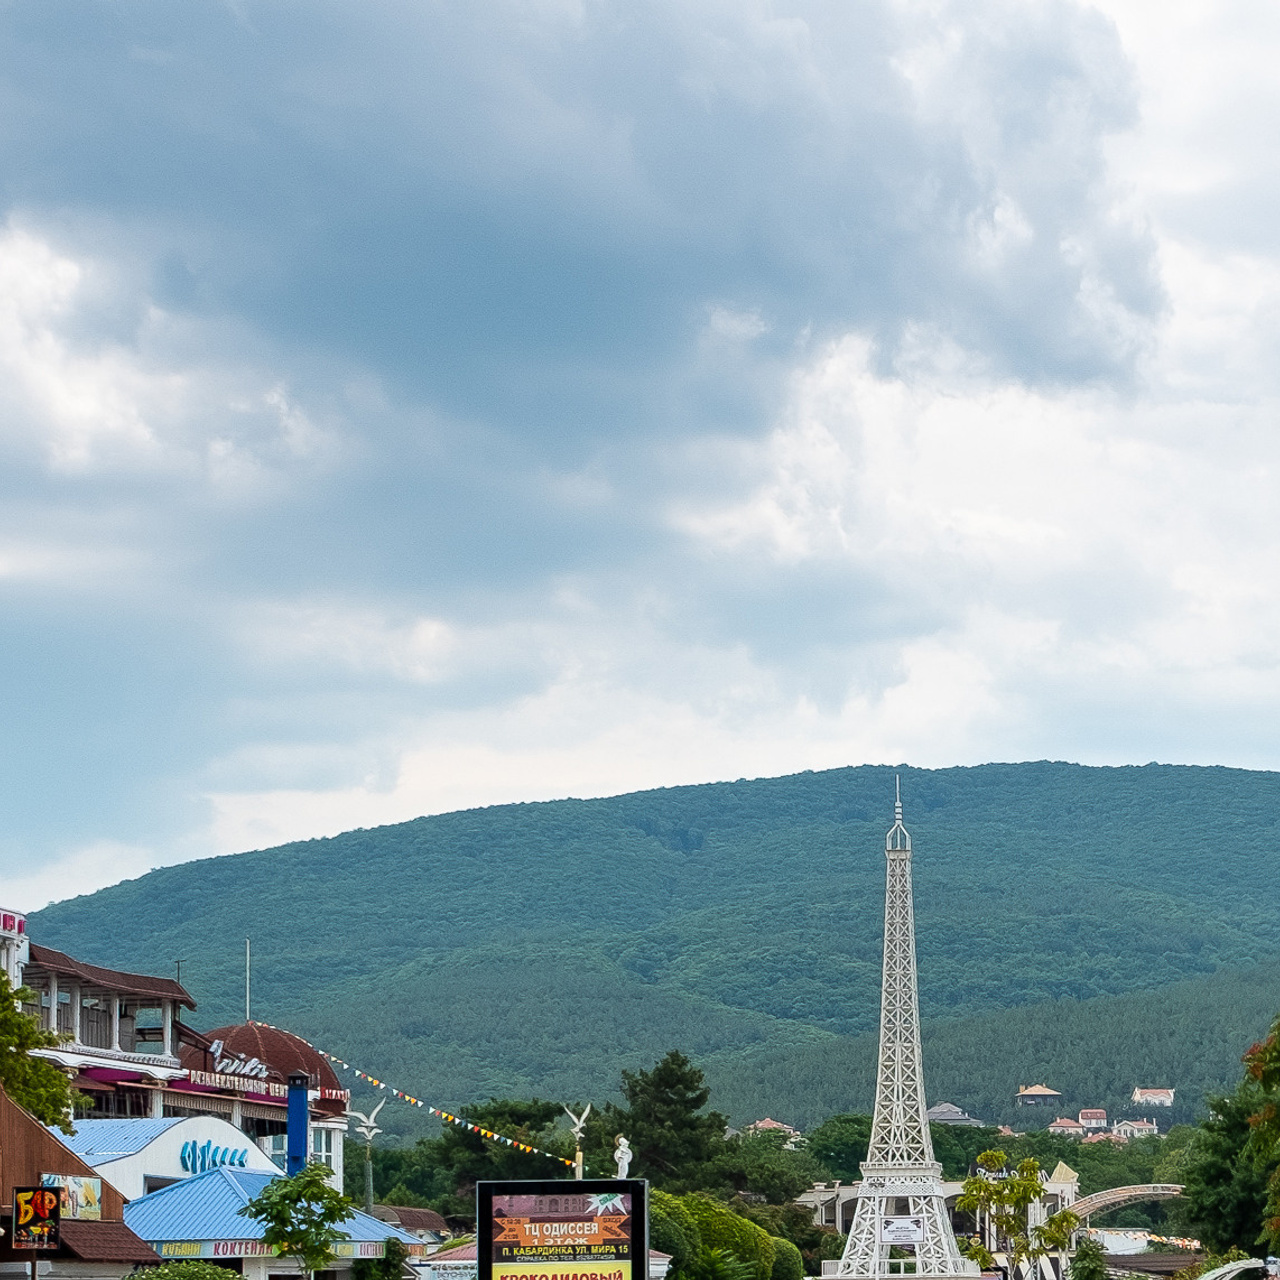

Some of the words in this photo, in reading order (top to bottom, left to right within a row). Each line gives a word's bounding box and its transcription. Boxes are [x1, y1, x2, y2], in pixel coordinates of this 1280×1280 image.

[269, 1082, 288, 1098] ЦЕНТ
[524, 1223, 540, 1237] ТЦ
[543, 1223, 599, 1236] ОДИССЕЯ
[544, 1237, 588, 1245] ЭТАЖ
[503, 1248, 512, 1256] П.
[513, 1247, 573, 1256] КАБАРДИНКА
[575, 1246, 589, 1255] УЛ.
[591, 1245, 617, 1254] МИРА
[619, 1245, 629, 1253] 15
